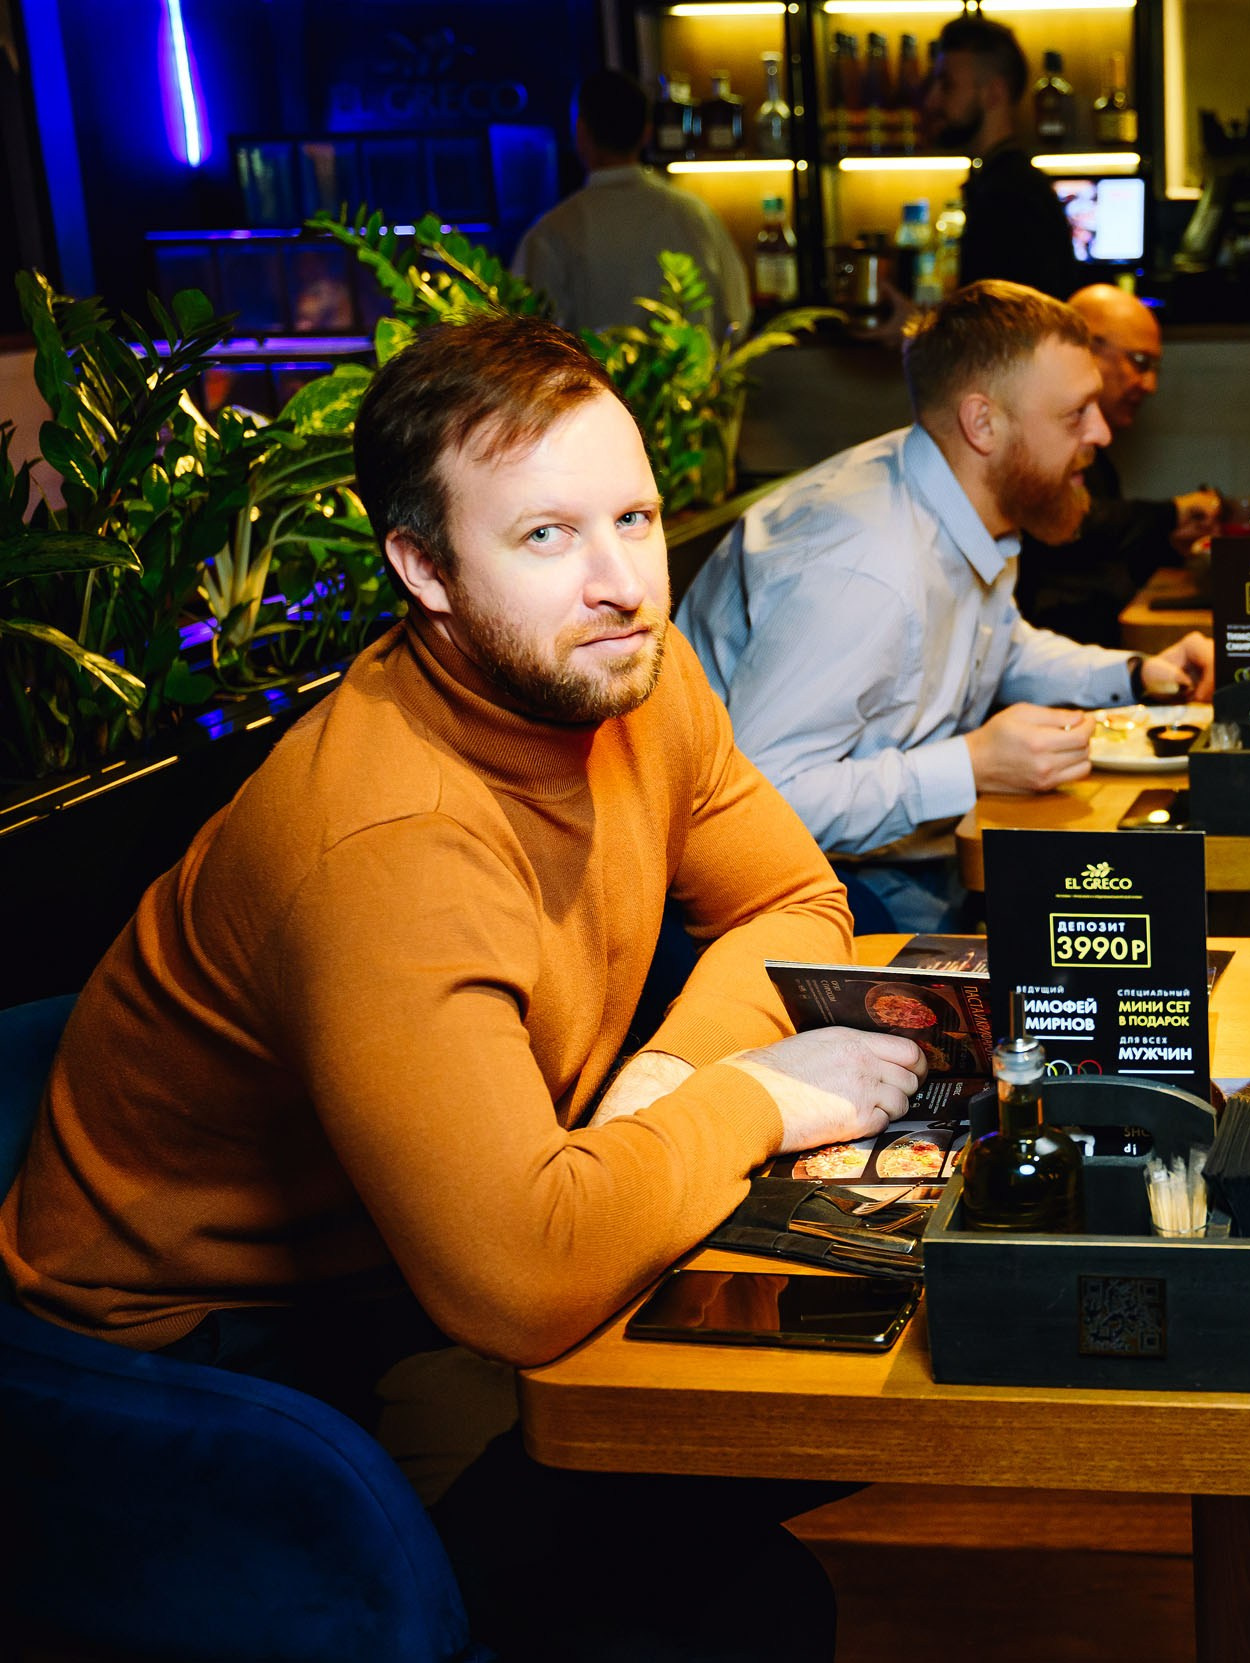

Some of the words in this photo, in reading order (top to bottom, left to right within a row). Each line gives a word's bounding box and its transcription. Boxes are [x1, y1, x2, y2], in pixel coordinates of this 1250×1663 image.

[383, 80, 528, 118] GRECO
[1065, 877, 1081, 890] EL
[1083, 877, 1132, 890] GRECO
[1057, 921, 1125, 932] ДЕПОЗИТ
[1016, 985, 1064, 994] ВЕДУЩИЙ
[1117, 988, 1190, 997] СПЕЦИАЛЬНЫЙ
[963, 985, 984, 1014] ПАСТА
[1024, 998, 1097, 1014] ИМОФЕЙ
[1119, 1001, 1163, 1013] МИНИ
[1166, 1001, 1191, 1013] СЕТ
[1025, 1017, 1095, 1031] МИРНОВ
[1119, 1016, 1126, 1026] В
[1129, 1016, 1190, 1028] ПОДАРОК
[1120, 1036, 1140, 1045] ДЛЯ
[1142, 1036, 1167, 1045] ВСЕХ
[1118, 1047, 1192, 1060] МУЖЧИН
